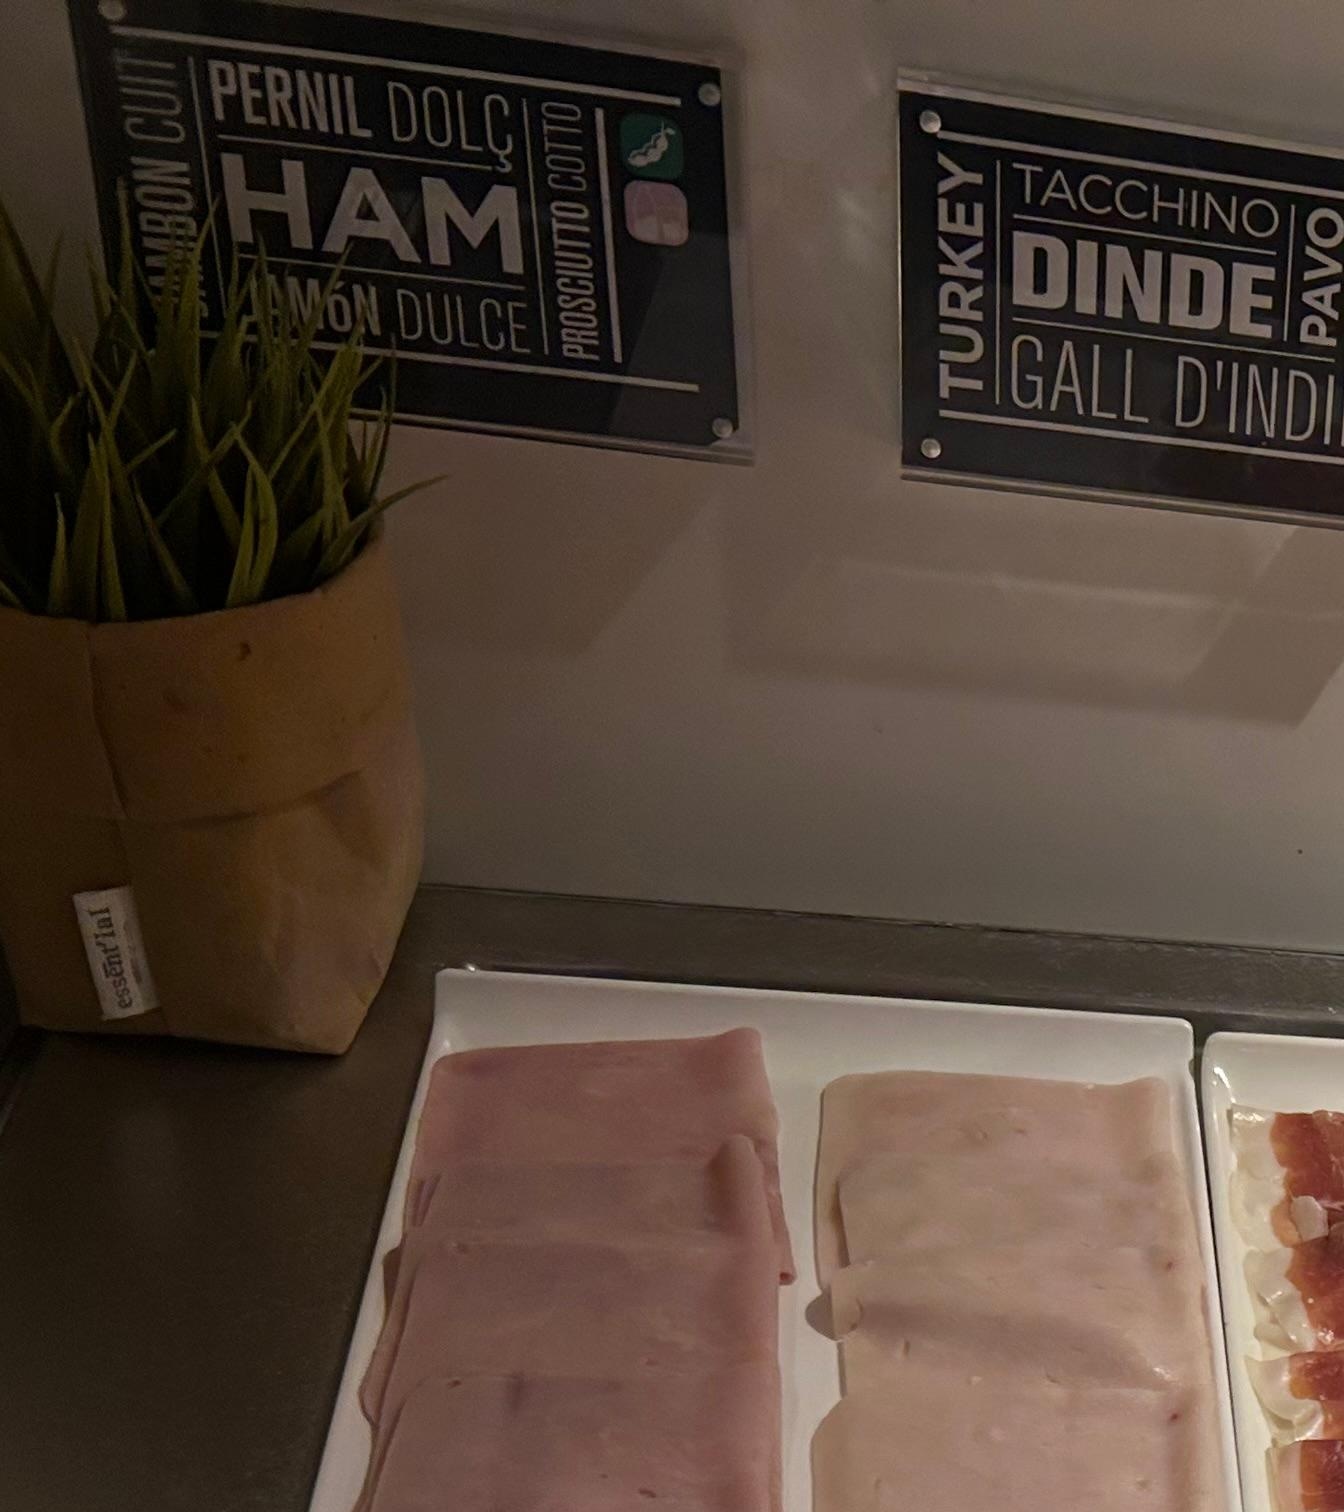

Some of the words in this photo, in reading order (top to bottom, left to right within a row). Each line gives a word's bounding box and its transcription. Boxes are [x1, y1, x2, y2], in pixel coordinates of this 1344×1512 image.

[112, 53, 184, 144] CUIT
[209, 59, 372, 138] PERNIL
[387, 81, 512, 173] DOLÇ
[541, 101, 585, 192] COTTO
[219, 153, 524, 275] HAM
[1012, 162, 1279, 238] TACCHINO
[397, 289, 531, 353] DULCE
[548, 199, 600, 361] PROSCIUTTO
[937, 152, 984, 399] TURKEY
[1012, 230, 1276, 339] DINDE
[1011, 334, 1149, 424] GALL
[1174, 355, 1334, 446] D'INDI
